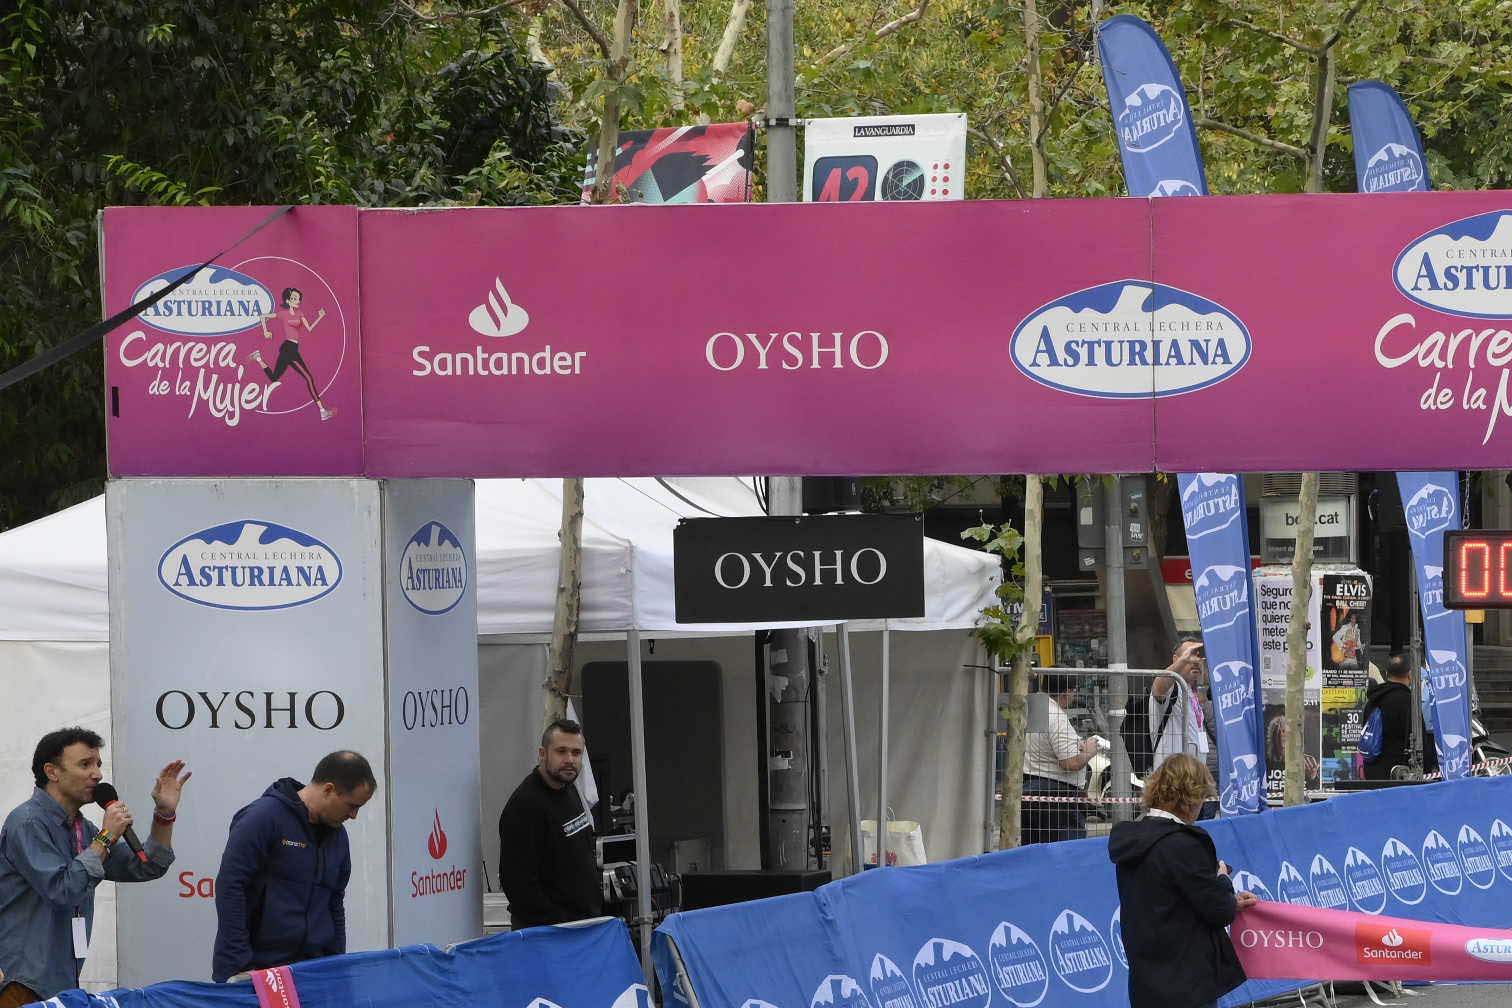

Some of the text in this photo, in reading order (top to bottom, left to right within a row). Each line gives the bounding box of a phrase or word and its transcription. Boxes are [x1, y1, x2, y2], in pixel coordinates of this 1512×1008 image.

[866, 125, 914, 136] VANGUARDIA
[143, 290, 263, 318] ASTURIANA
[1065, 319, 1226, 333] CENTRAL LECHERA
[119, 330, 237, 368] Carrera
[412, 345, 587, 376] Santander
[705, 331, 889, 370] OYSHO
[1028, 325, 1233, 368] ASTURIANA
[148, 365, 282, 427] de la Mujer
[1420, 371, 1454, 411] de
[1462, 370, 1487, 410] la
[172, 554, 329, 588] ASTURIANA
[200, 552, 323, 561] CENTRAL LECHERA
[714, 548, 887, 589] OYSHO
[405, 556, 463, 591] ASTURIANA
[1261, 601, 1278, 611] que
[1336, 583, 1367, 597] ELVIS
[1262, 626, 1288, 637] mete
[1262, 641, 1281, 651] este
[156, 690, 345, 731] OYSHO
[403, 686, 469, 732] OYSHO
[1346, 713, 1359, 724] 30
[411, 866, 467, 899] Santander
[1240, 928, 1324, 950] OYSHO
[1363, 947, 1423, 960] Santander
[994, 957, 1046, 989] ASTURIANA
[1055, 943, 1110, 975] ASTURIANA
